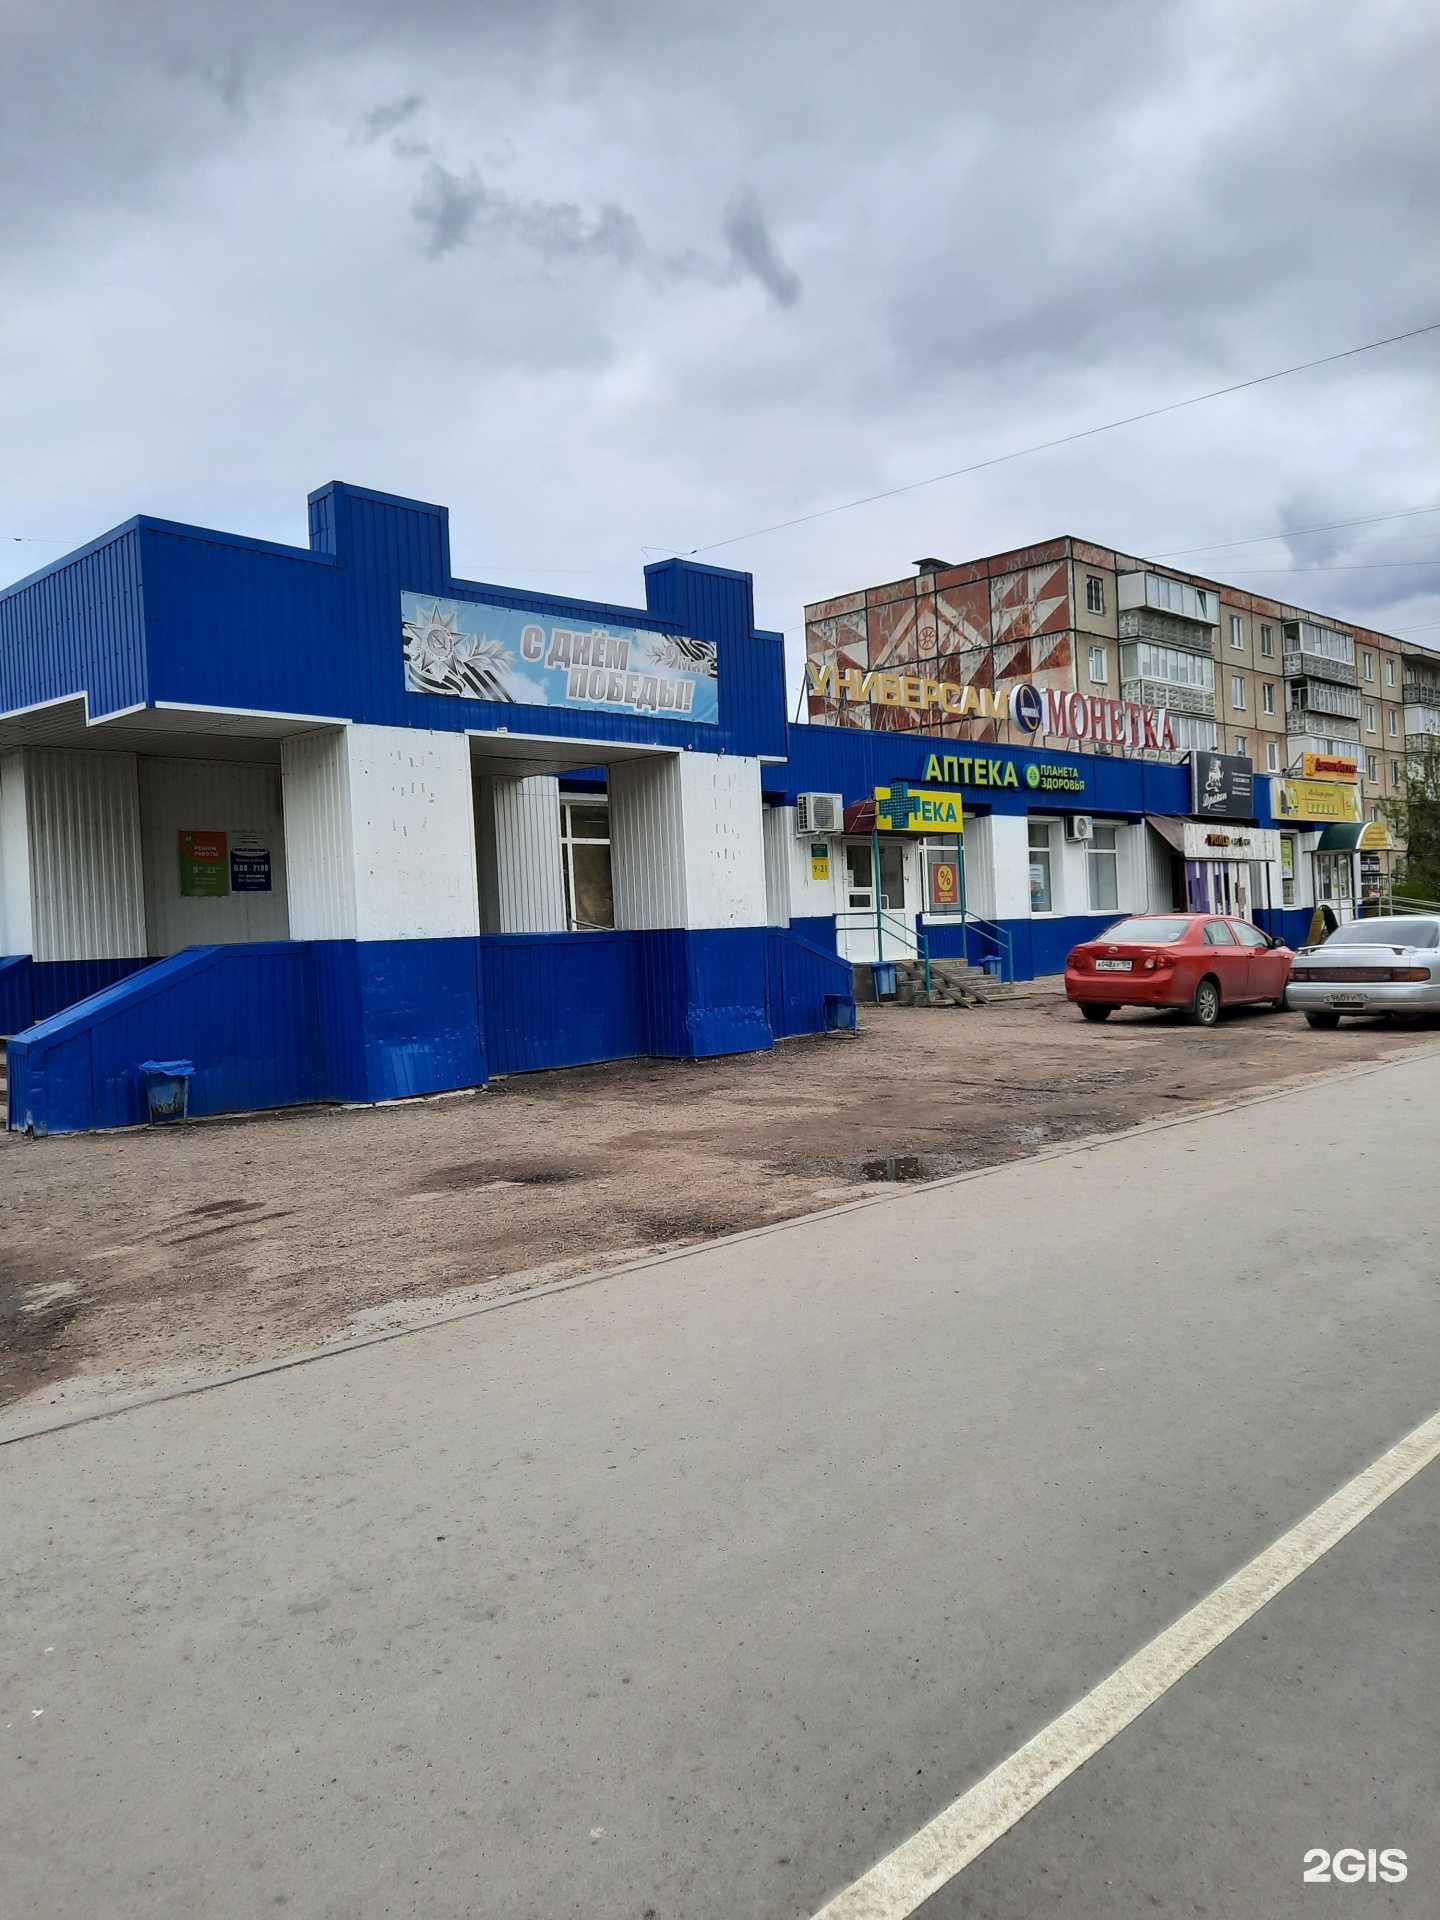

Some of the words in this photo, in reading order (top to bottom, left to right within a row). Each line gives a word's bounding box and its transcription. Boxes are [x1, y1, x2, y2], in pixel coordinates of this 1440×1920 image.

[521, 625, 546, 662] С
[545, 629, 631, 672] ДНЁМ
[566, 667, 696, 713] ПОБЕДЫ!
[804, 661, 1009, 720] УНИВЕРСАМ
[1042, 687, 1178, 752] МОНЕТКА
[923, 753, 1019, 788] АПТЕКА
[1040, 764, 1079, 779] ПЛАНЕТА
[1041, 777, 1086, 792] ЗДОРОВЬЯ
